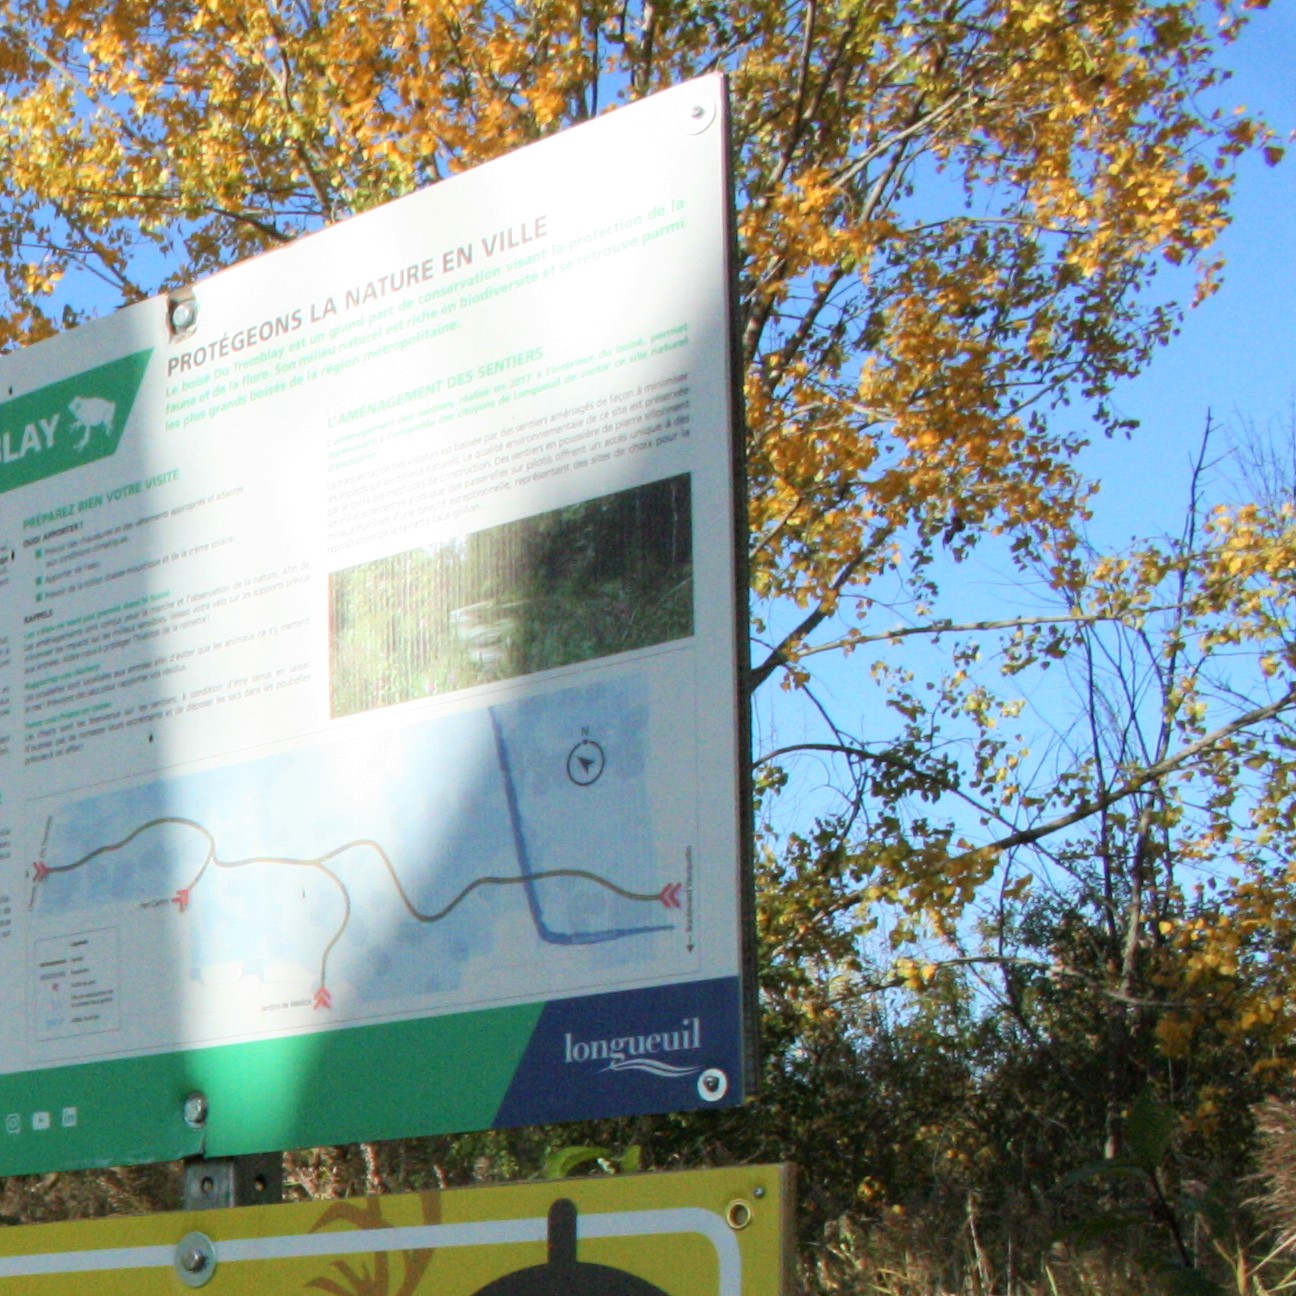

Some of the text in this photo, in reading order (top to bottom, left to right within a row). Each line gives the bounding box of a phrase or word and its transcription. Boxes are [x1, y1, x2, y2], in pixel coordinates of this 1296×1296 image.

[165, 200, 684, 397] Le boisé Du Tremblay est un grand parc de conservation visant la protection de la
[165, 396, 196, 414] faune
[198, 388, 210, 403] et
[211, 384, 226, 398] de
[228, 380, 238, 392] la
[274, 360, 296, 376] Son
[298, 346, 336, 367] milieu
[338, 326, 382, 353] naturel
[385, 318, 404, 336] est
[406, 309, 437, 329] riche
[440, 303, 457, 317] en
[458, 270, 539, 310] biodiversité
[541, 264, 555, 281] et
[558, 261, 574, 275] se
[576, 238, 638, 268] retrouve
[641, 217, 685, 248] parmi
[166, 214, 548, 378] PROTÉGEONS LA NATURE EN VILLE
[165, 420, 180, 432] les
[182, 411, 206, 428] plus
[207, 395, 247, 420] grands
[248, 381, 286, 403] boisés
[288, 375, 303, 389] de
[306, 370, 317, 383] la
[320, 356, 360, 378] région
[327, 346, 543, 430] L'AMÉNAGEMENT DES SENTIERS
[22, 469, 179, 531] PRÉPAREZ BIEN VOTRE VISITE
[564, 1017, 702, 1065] longueuil
